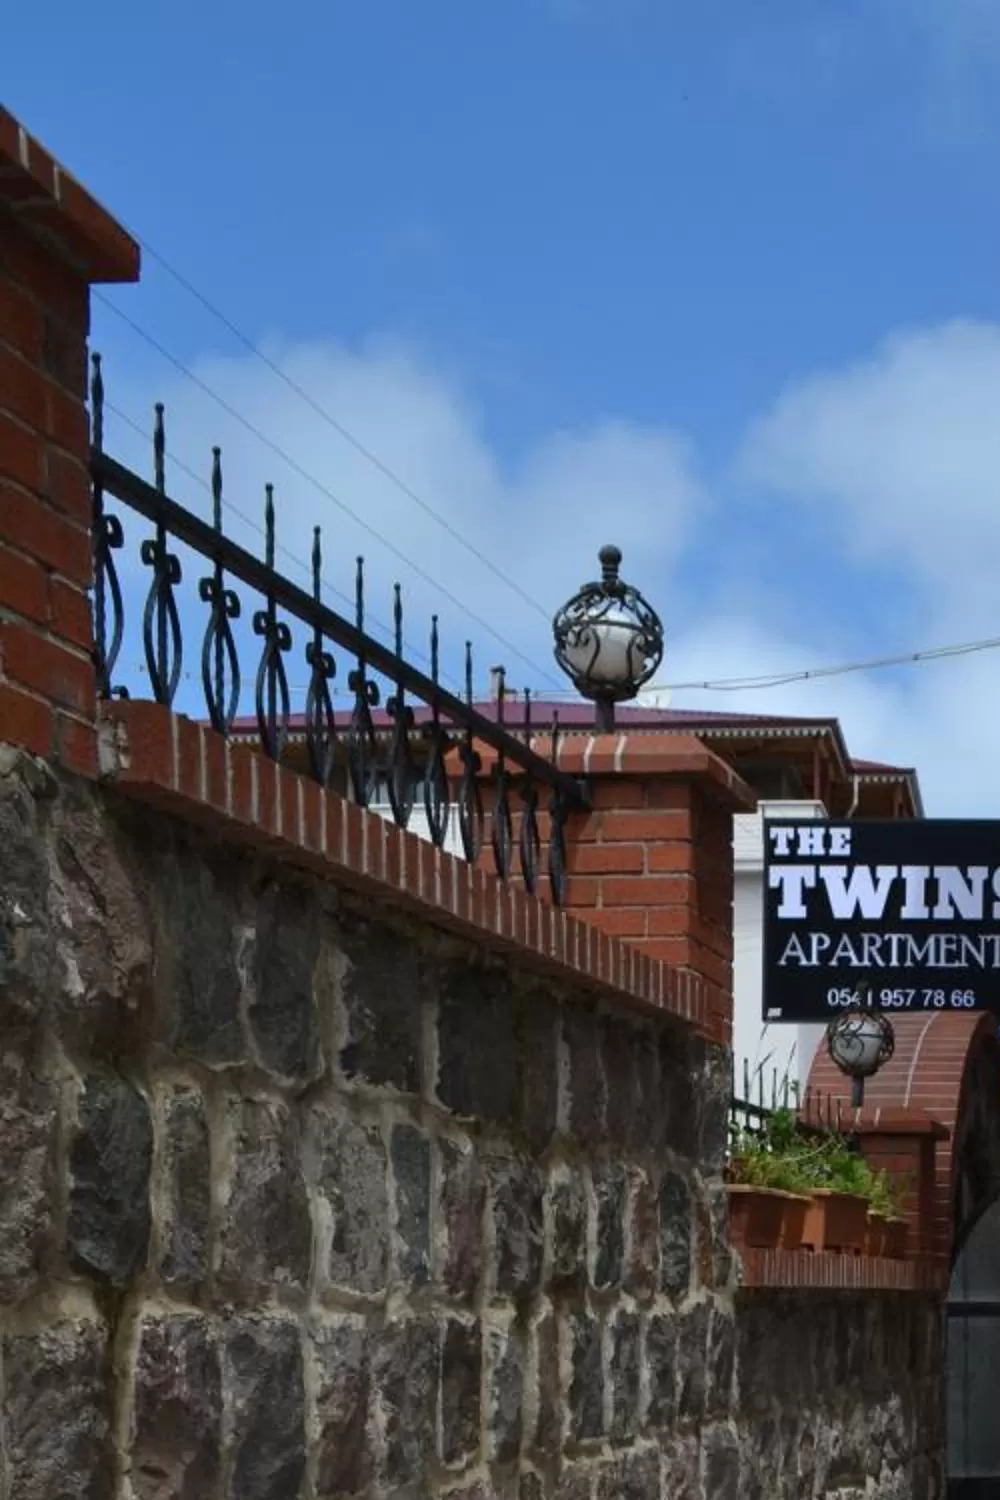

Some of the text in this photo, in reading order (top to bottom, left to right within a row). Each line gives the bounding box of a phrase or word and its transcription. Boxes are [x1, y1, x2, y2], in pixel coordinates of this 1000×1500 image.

[769, 826, 851, 856] THE
[880, 988, 916, 1007] 957
[922, 989, 945, 1007] 78
[951, 989, 975, 1007] 66
